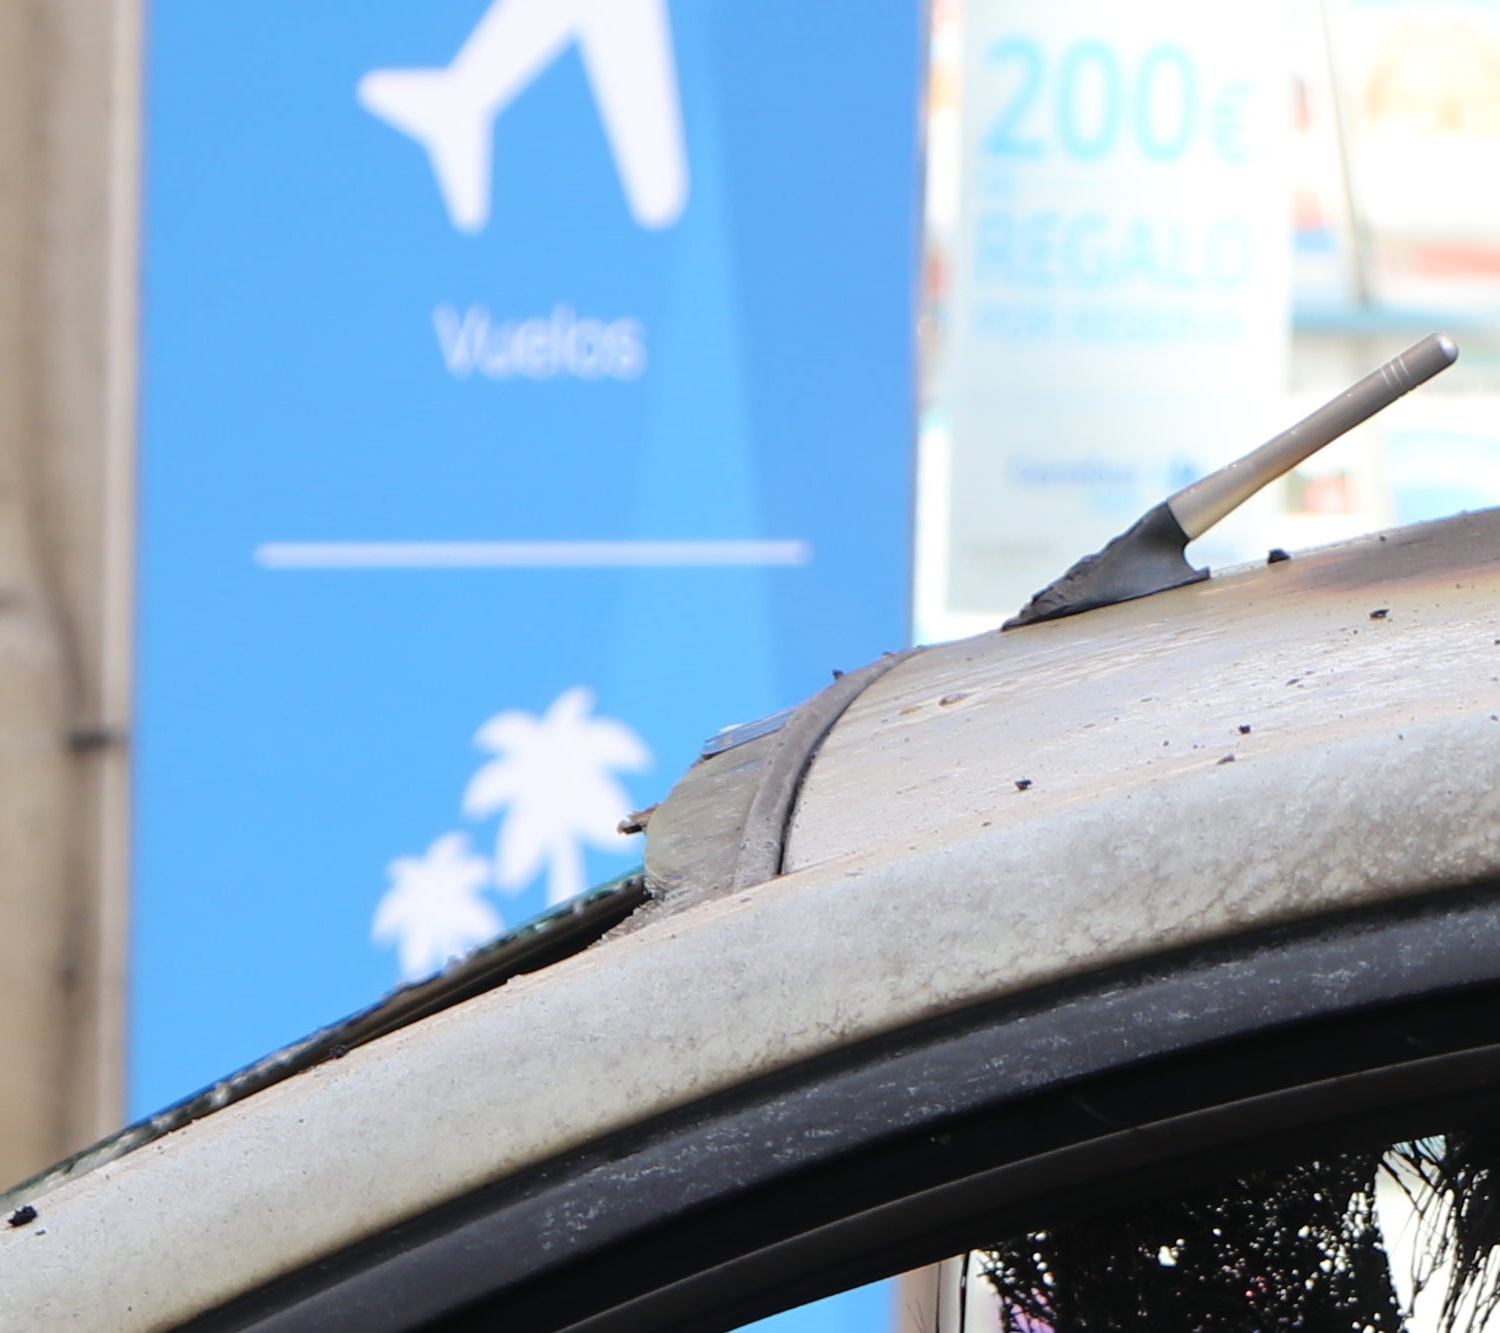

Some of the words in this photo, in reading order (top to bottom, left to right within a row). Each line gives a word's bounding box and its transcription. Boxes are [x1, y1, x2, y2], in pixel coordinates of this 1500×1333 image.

[982, 35, 1253, 165] 200€
[976, 209, 1251, 291] REGALO
[432, 302, 647, 380] Vuelos
